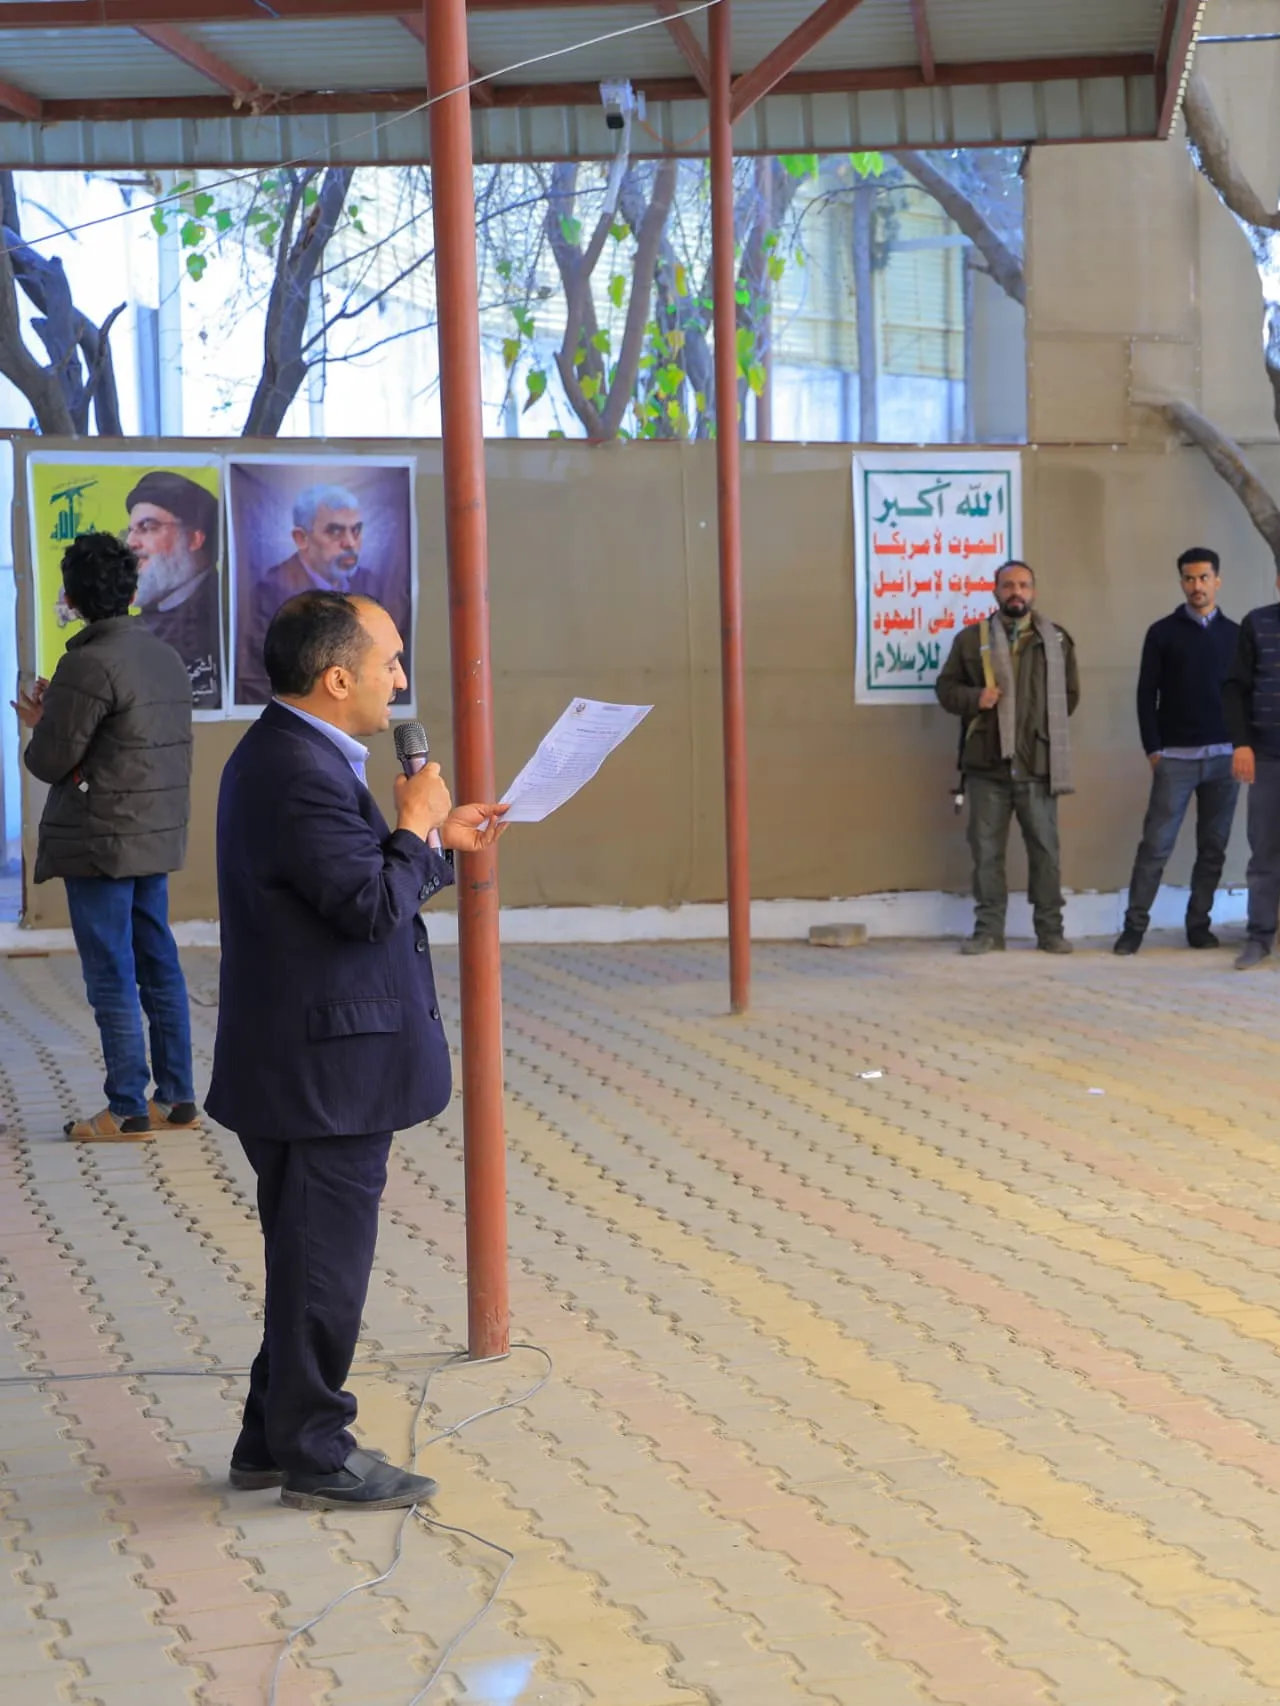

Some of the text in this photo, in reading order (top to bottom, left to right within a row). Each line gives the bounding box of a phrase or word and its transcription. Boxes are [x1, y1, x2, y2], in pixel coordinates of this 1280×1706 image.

[872, 477, 1004, 529] الله أكبر
[948, 531, 1004, 560] الموت
[948, 572, 996, 598] موت
[873, 606, 922, 636] اليهود
[928, 606, 955, 635] على
